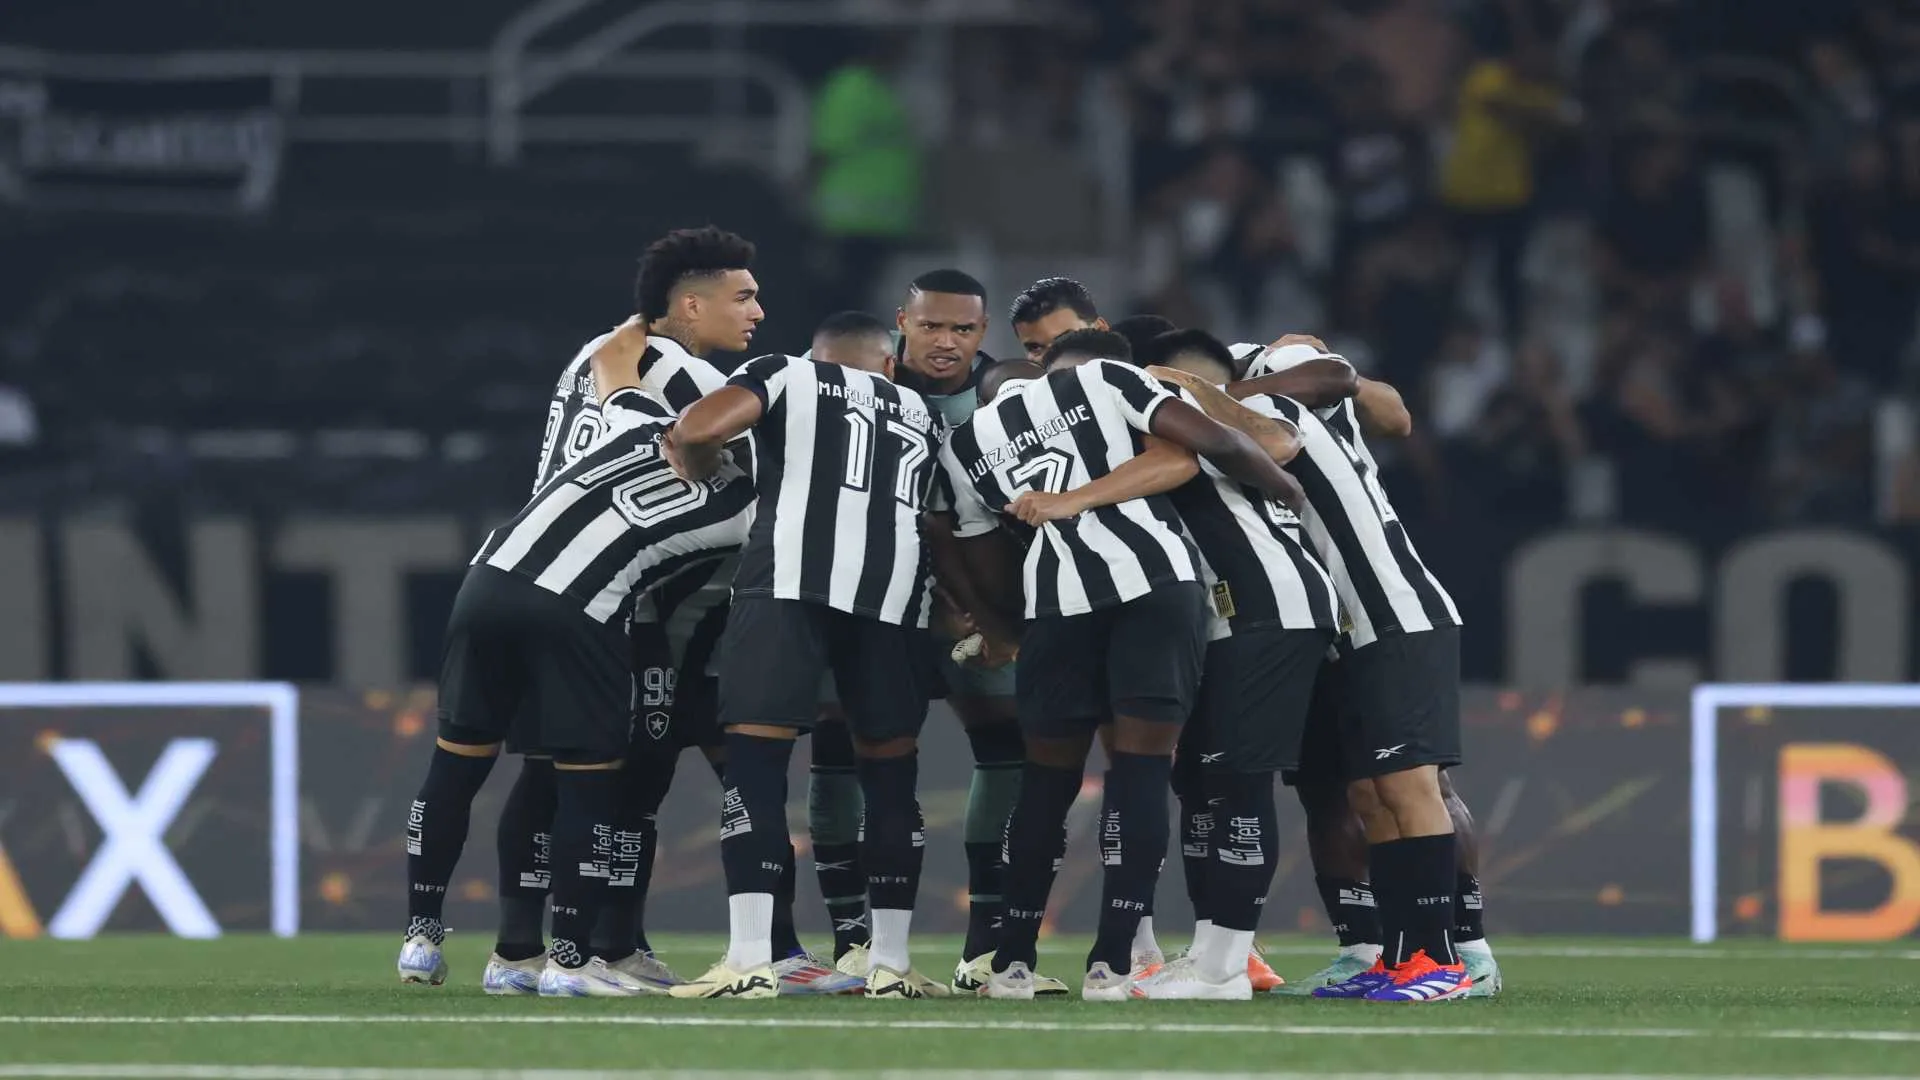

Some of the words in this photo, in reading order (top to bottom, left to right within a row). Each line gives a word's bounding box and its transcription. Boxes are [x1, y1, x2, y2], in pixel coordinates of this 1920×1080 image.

[818, 381, 885, 411] MARLON
[843, 411, 930, 504] 17
[968, 447, 1005, 482] LUIZ
[1006, 404, 1091, 458] HENRIQUE
[1011, 451, 1069, 496] 7
[1779, 742, 1920, 942] B
[1111, 899, 1145, 911] BFR
